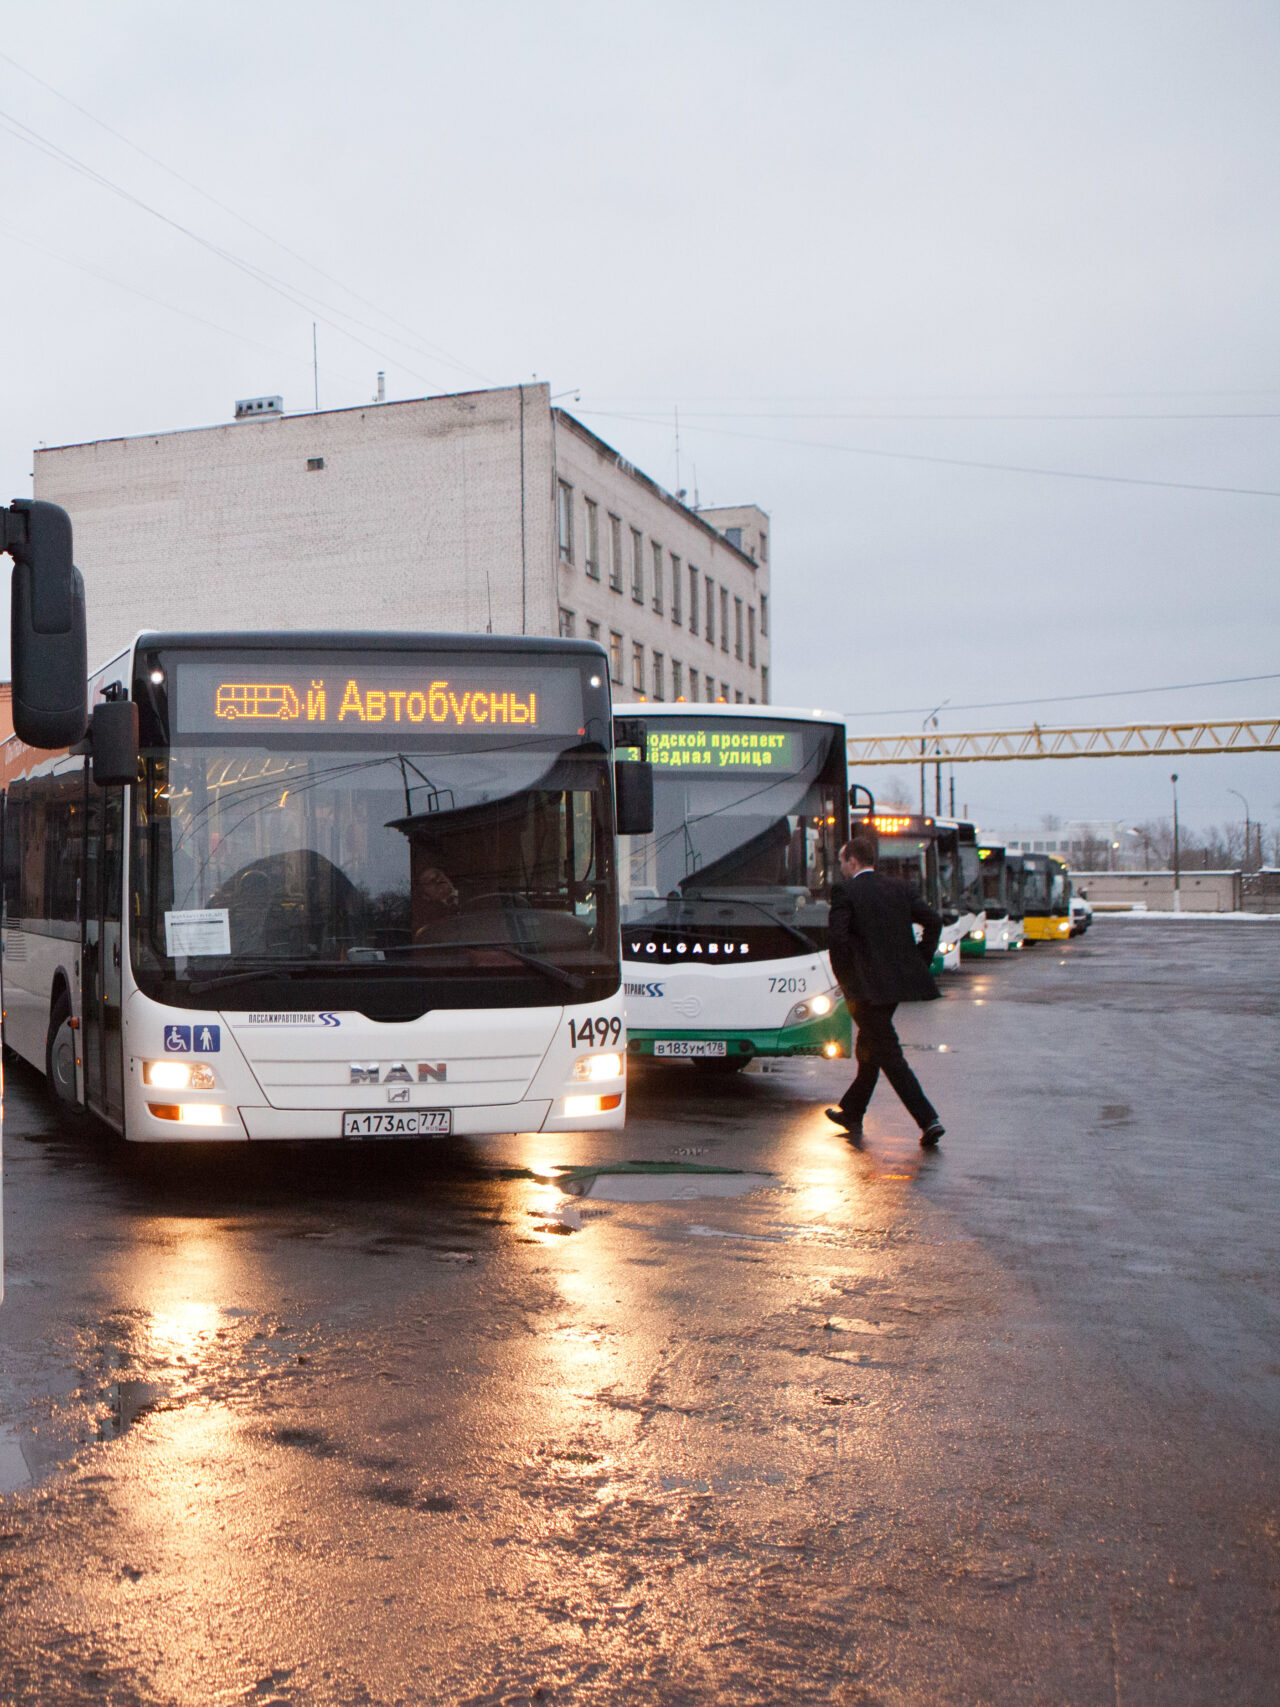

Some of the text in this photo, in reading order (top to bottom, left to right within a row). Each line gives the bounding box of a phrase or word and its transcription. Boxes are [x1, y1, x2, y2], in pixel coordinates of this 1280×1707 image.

[338, 680, 536, 725] Автобусны
[646, 731, 785, 749] одской проспект
[627, 747, 772, 766] Зёздная улица
[631, 943, 749, 954] VOLGABUS
[768, 978, 807, 992] 7203
[249, 1014, 315, 1024] ПАССАЖИРАВТОТРАНС
[568, 1016, 622, 1048] 1499
[706, 1042, 723, 1051] 178
[350, 1063, 447, 1083] MAN
[350, 1113, 446, 1133] А173АС 777
